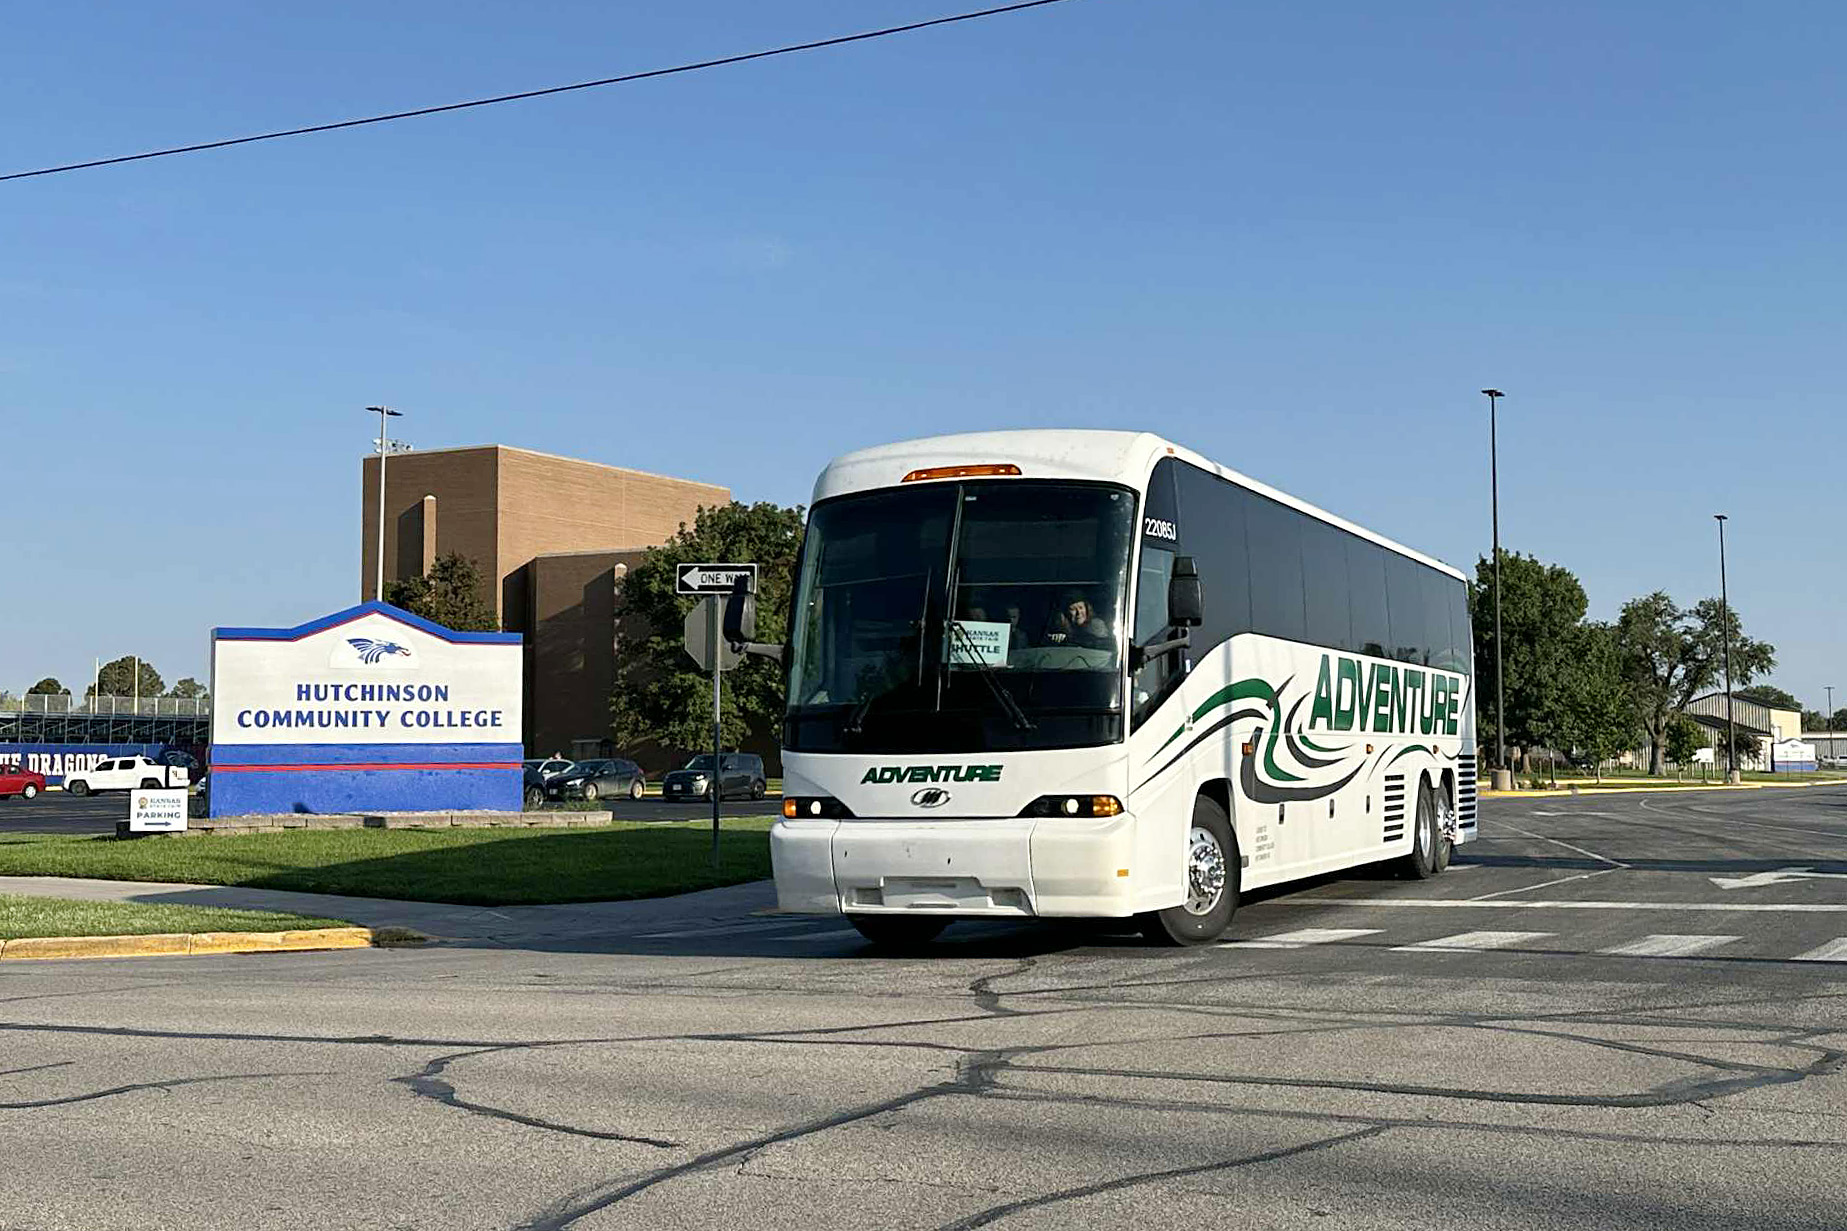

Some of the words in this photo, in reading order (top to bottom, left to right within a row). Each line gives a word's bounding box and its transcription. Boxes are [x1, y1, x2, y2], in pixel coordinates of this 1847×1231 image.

[1145, 517, 1176, 540] 22085J
[700, 573, 722, 583] ONE
[296, 684, 449, 702] HUTCHINSON
[1308, 654, 1459, 735] ADVENTURE
[237, 710, 391, 728] COMMUNITY
[400, 710, 503, 728] COLLEGE
[860, 765, 1003, 784] ADVENTURE
